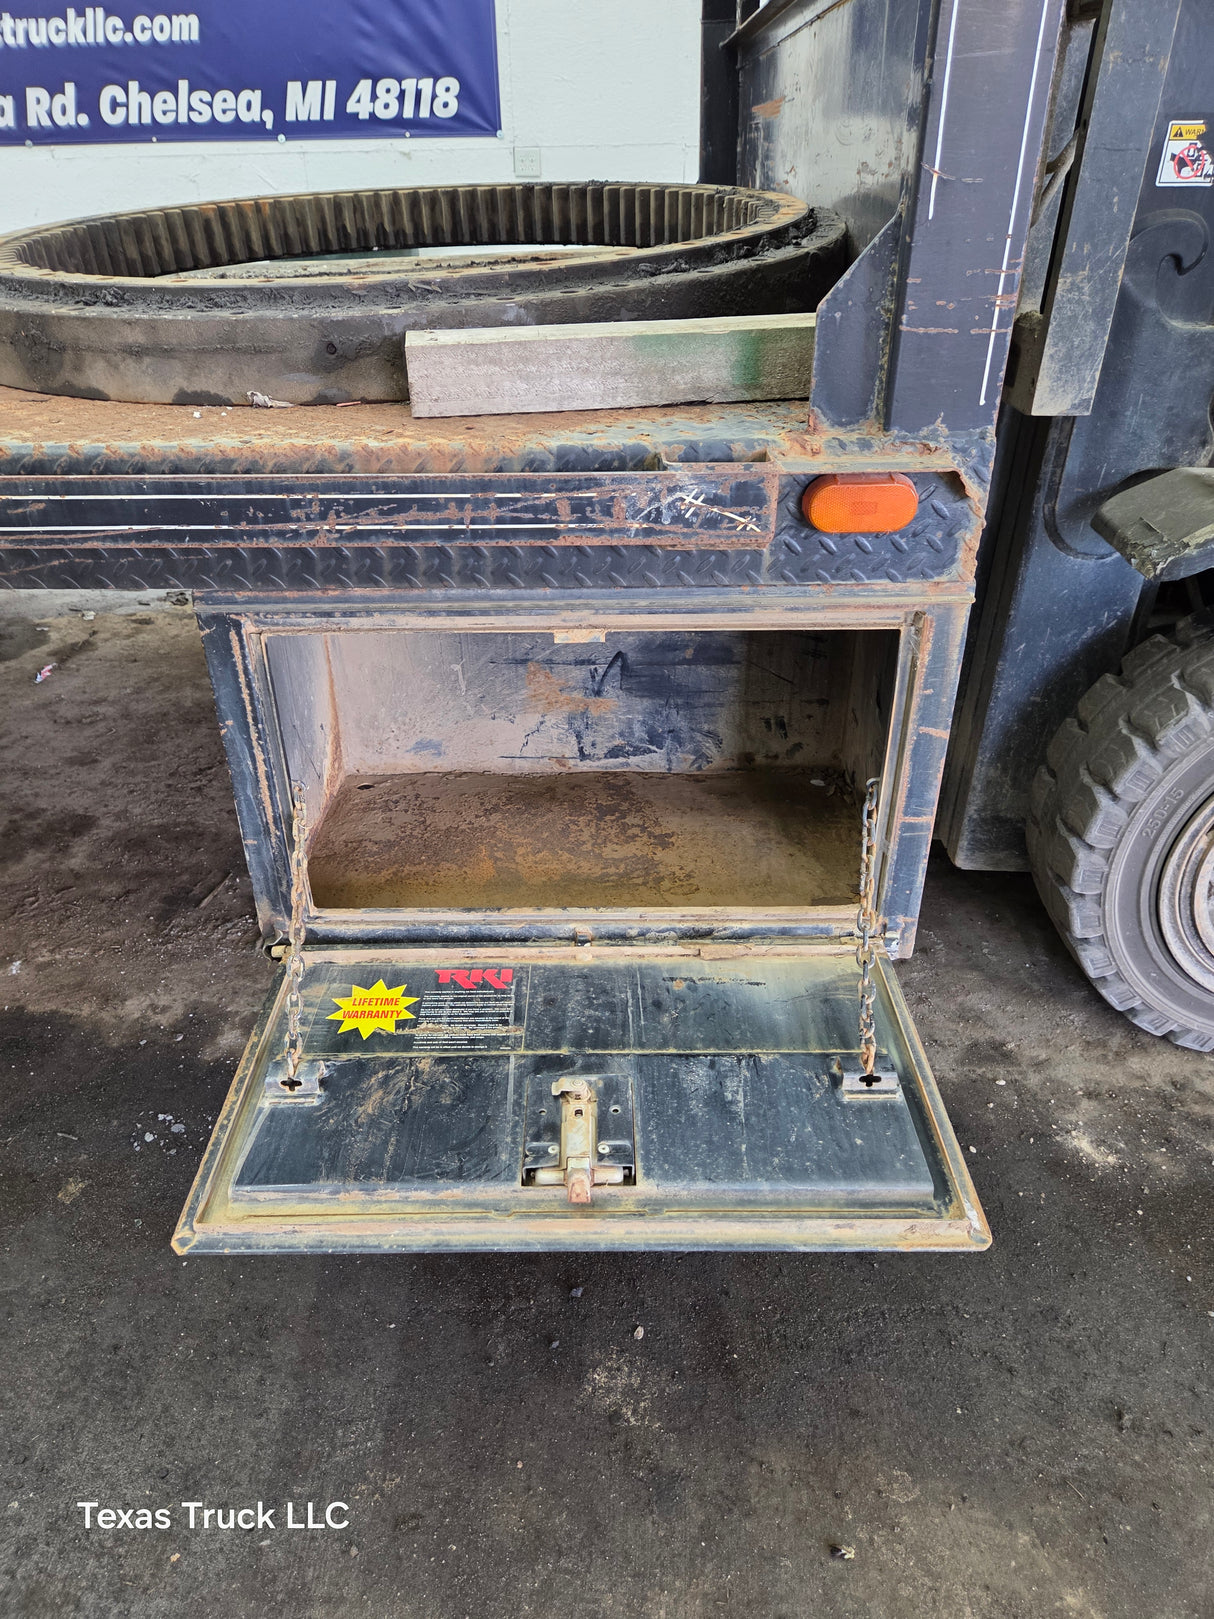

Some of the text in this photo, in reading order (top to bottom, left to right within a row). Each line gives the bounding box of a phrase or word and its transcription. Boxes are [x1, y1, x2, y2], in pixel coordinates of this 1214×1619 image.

[0, 7, 200, 47] truckllc.com
[25, 82, 90, 128] Rd.
[100, 79, 274, 130] Chelsea,
[285, 80, 338, 123] MI
[346, 76, 460, 120] 48118
[434, 969, 513, 989] RKI
[352, 997, 401, 1006] LIFETIME
[342, 1010, 403, 1019] WARRANTY
